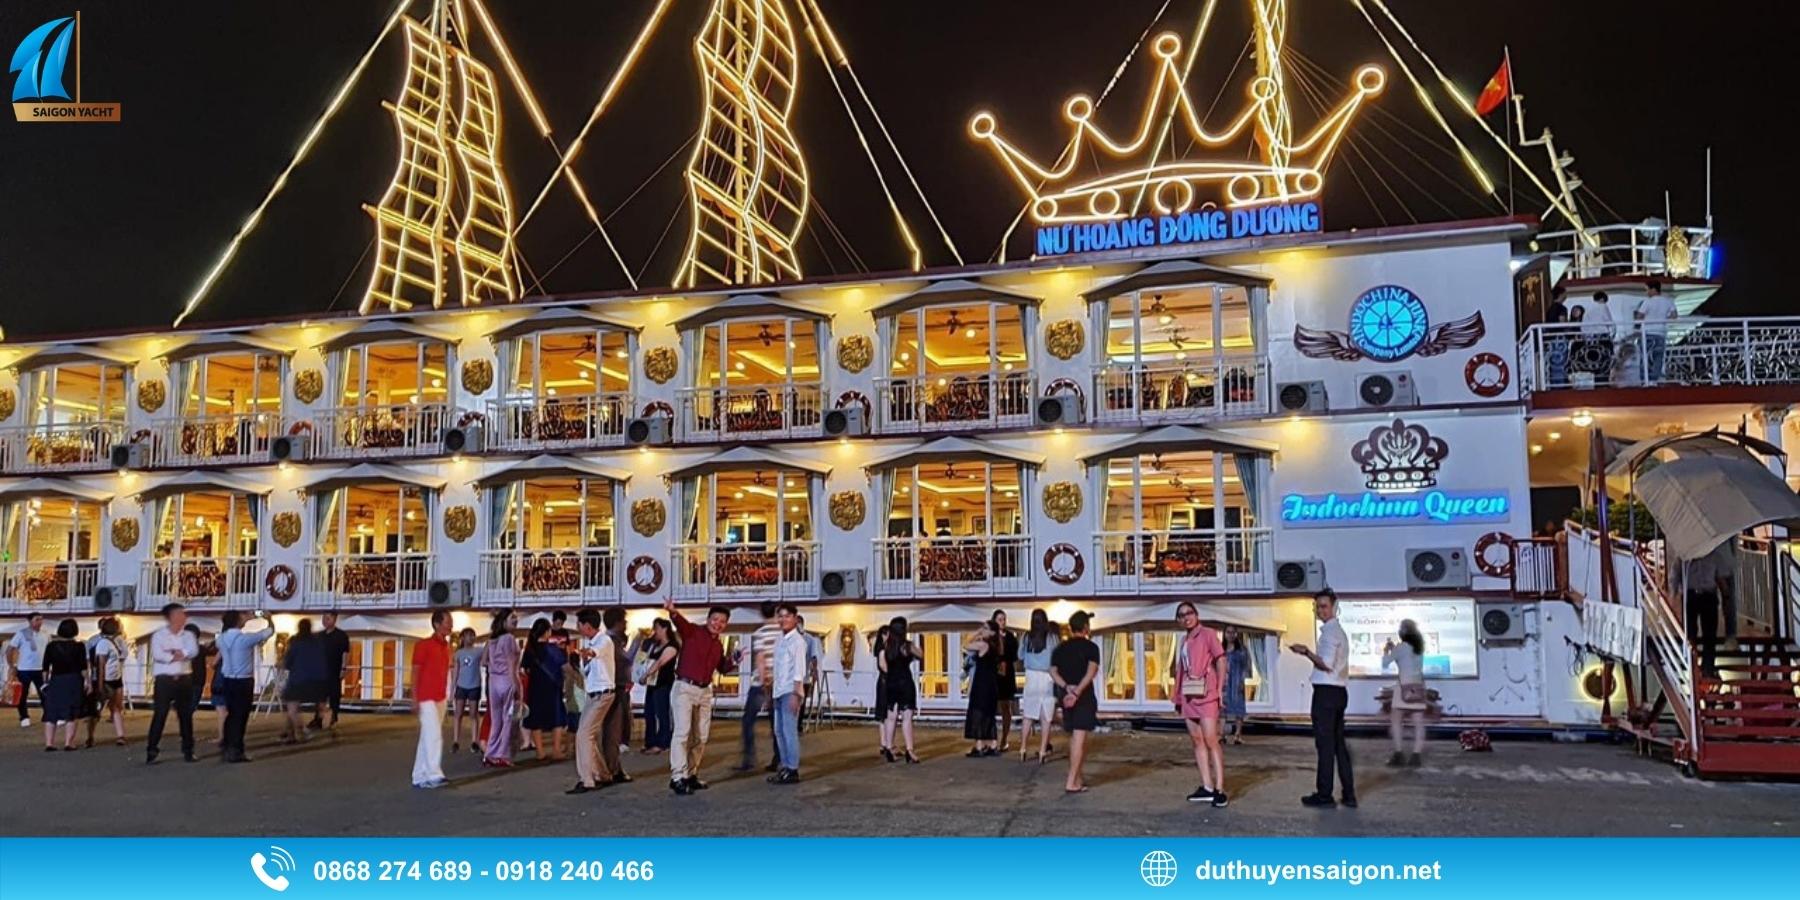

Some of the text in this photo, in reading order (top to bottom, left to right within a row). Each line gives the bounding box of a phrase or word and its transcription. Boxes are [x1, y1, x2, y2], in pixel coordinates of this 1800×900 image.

[1351, 287, 1427, 342] INDOCHINA JUNK
[1282, 490, 1508, 522] Indochina Queen
